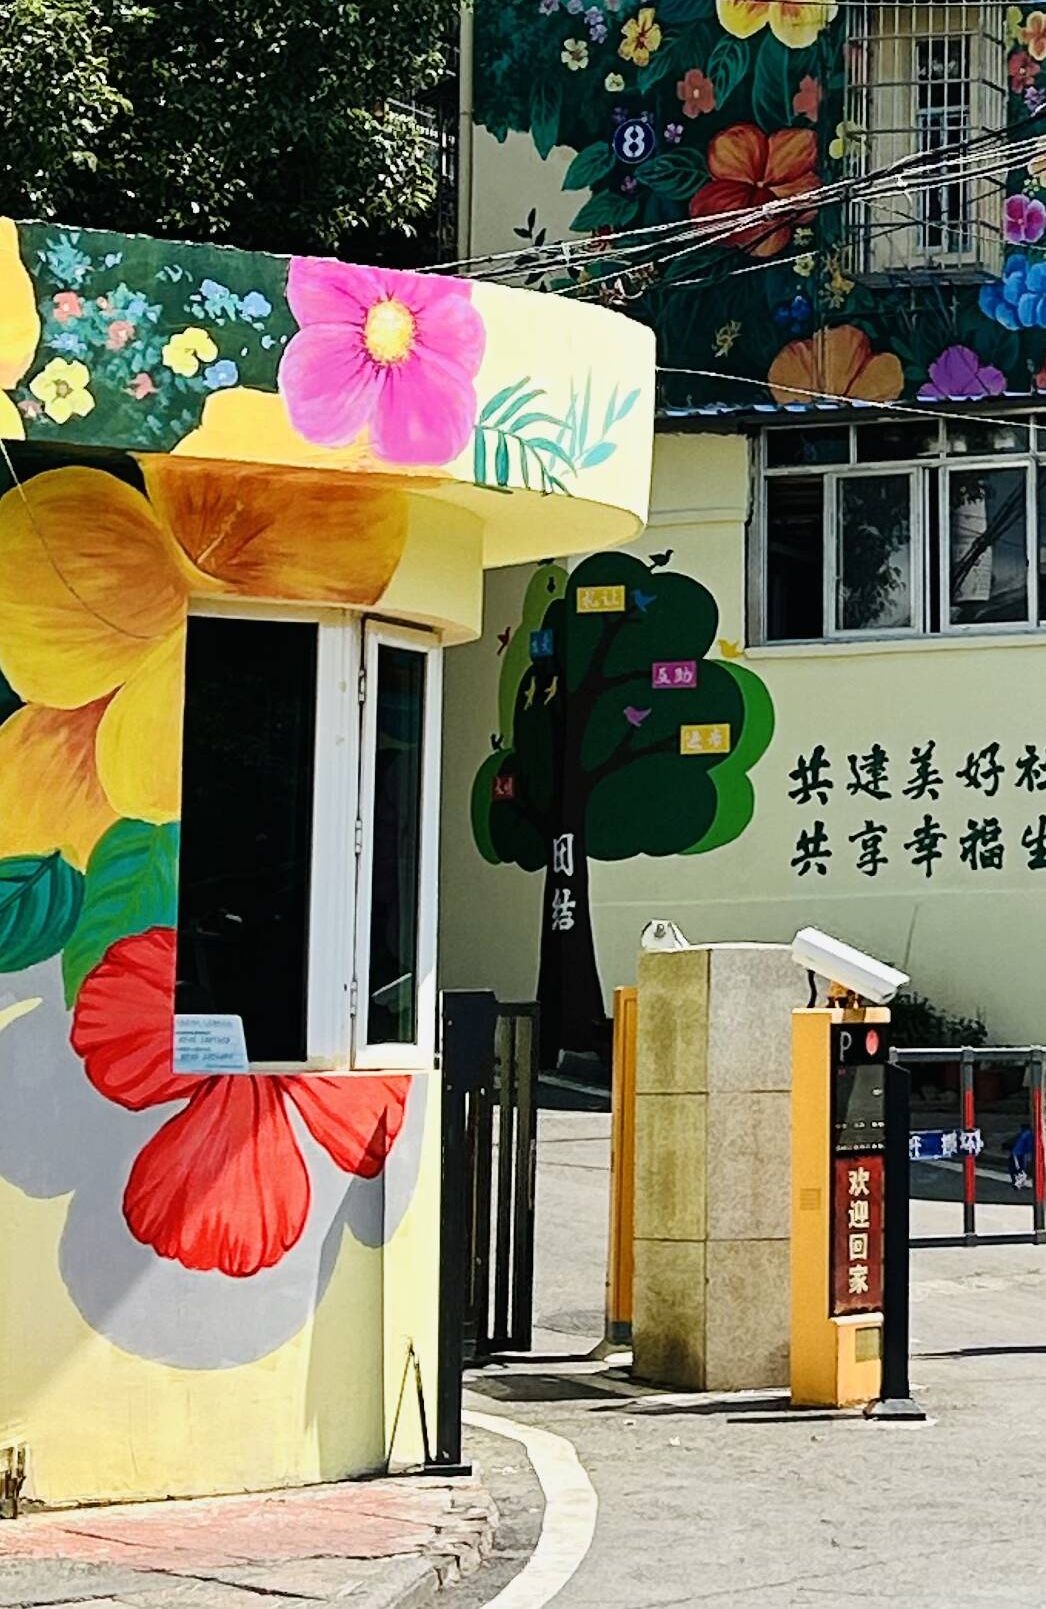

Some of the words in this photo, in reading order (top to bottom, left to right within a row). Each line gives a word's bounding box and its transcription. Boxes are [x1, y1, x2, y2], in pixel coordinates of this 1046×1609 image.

[622, 125, 645, 158] 8
[655, 668, 692, 684] 互助
[552, 832, 576, 931] 团结
[839, 1031, 852, 1062] P
[848, 1166, 870, 1294] 欢迎回家
